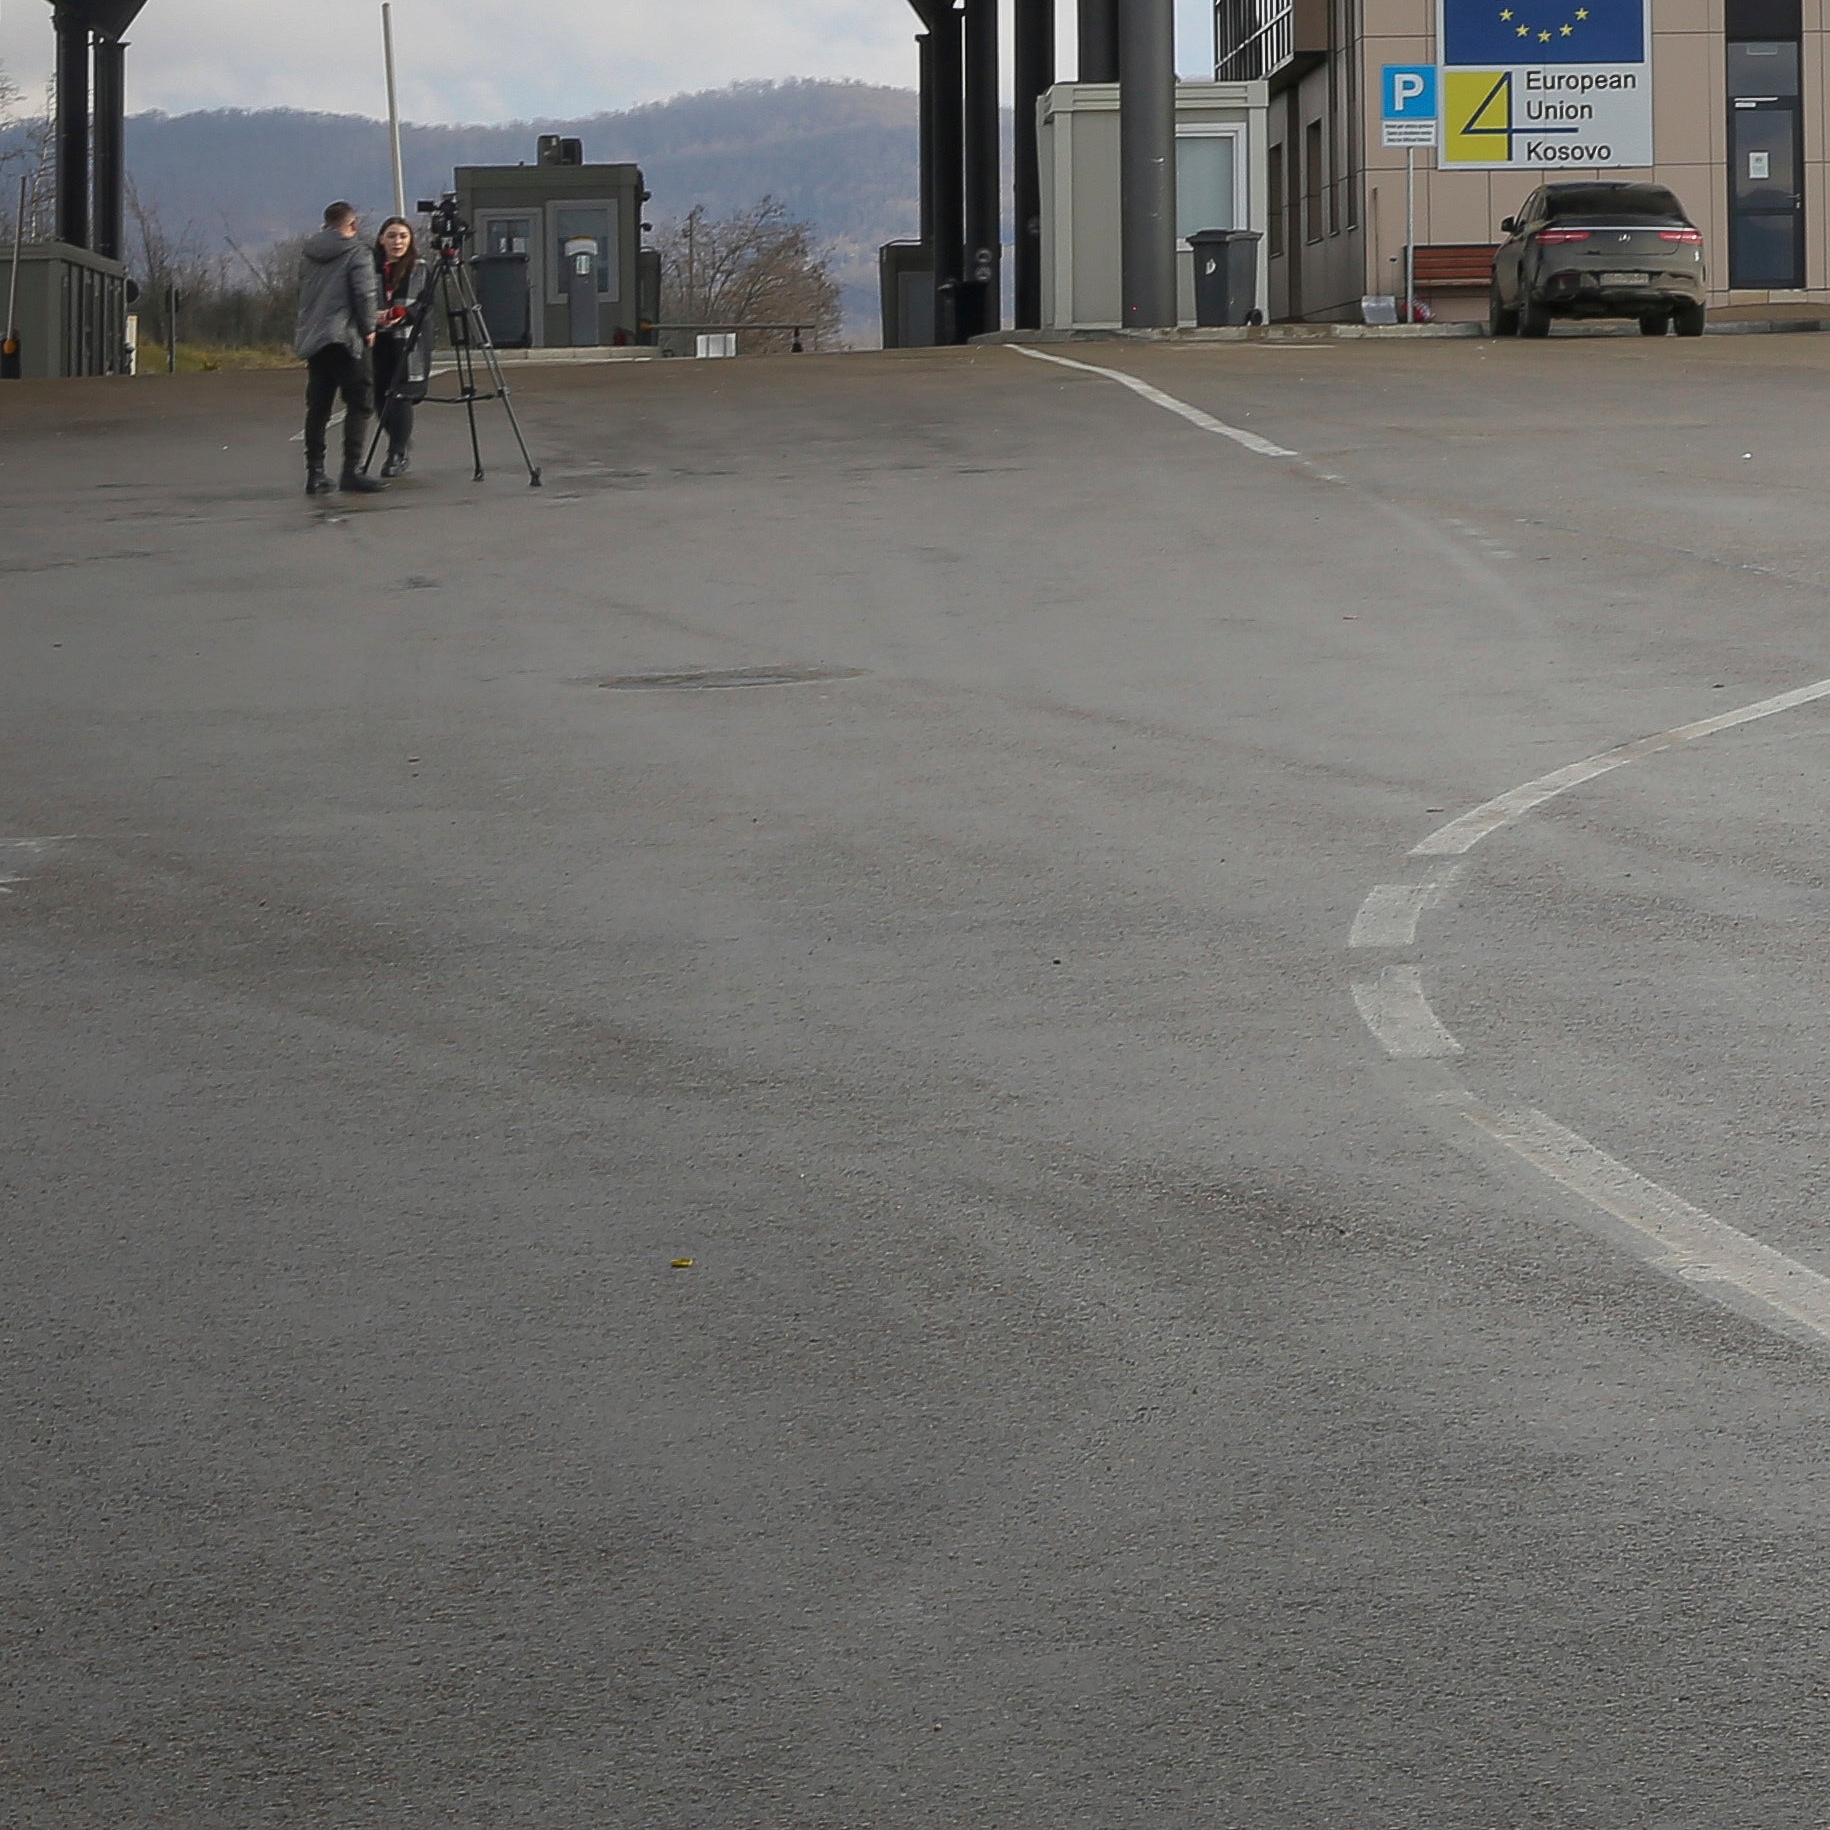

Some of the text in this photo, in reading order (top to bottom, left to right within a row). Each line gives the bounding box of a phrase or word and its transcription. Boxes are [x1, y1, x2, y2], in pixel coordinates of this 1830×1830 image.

[1394, 73, 1425, 112] P
[1526, 70, 1636, 94] European
[1526, 99, 1594, 121] Union
[1527, 141, 1612, 162] Kosovo
